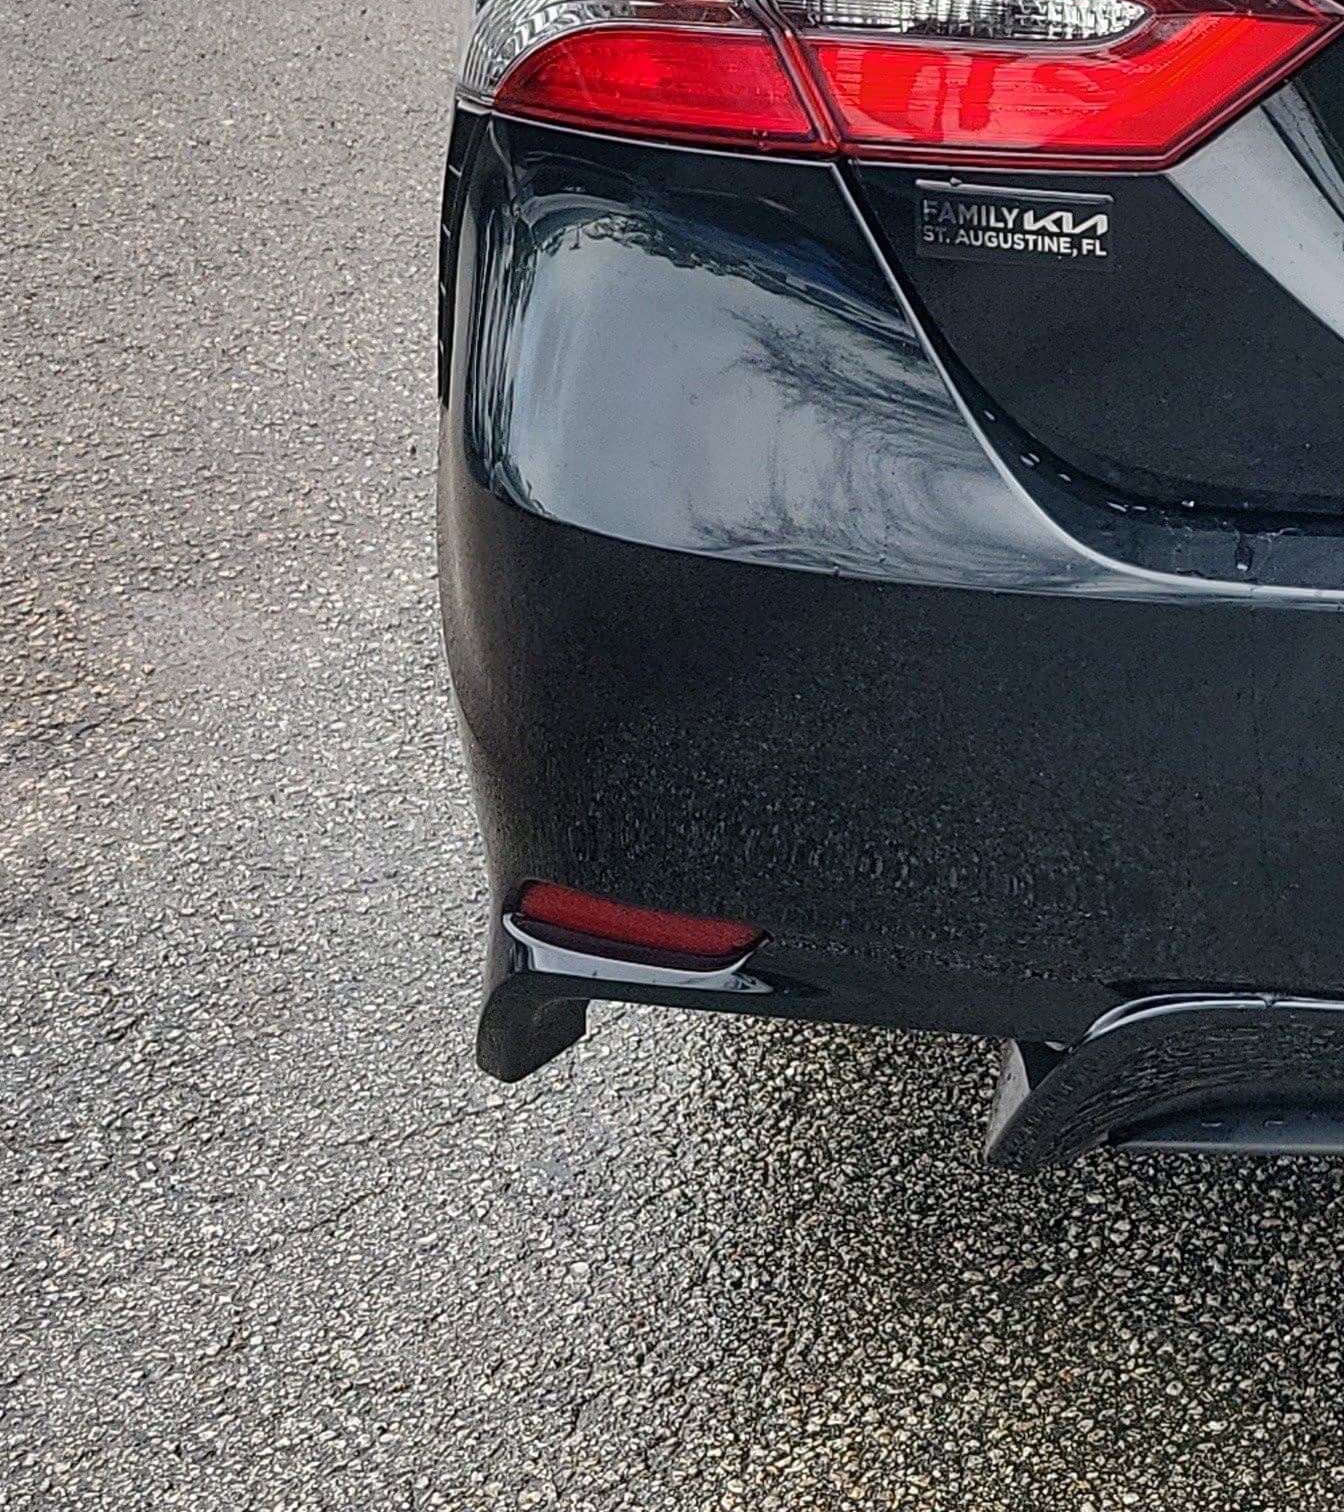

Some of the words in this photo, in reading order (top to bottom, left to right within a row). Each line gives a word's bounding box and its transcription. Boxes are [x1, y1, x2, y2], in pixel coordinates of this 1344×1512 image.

[923, 199, 1019, 229] FAMILY
[923, 225, 950, 244] ST.
[955, 229, 1078, 258] AUGUSTINE,
[1081, 238, 1107, 256] FL
